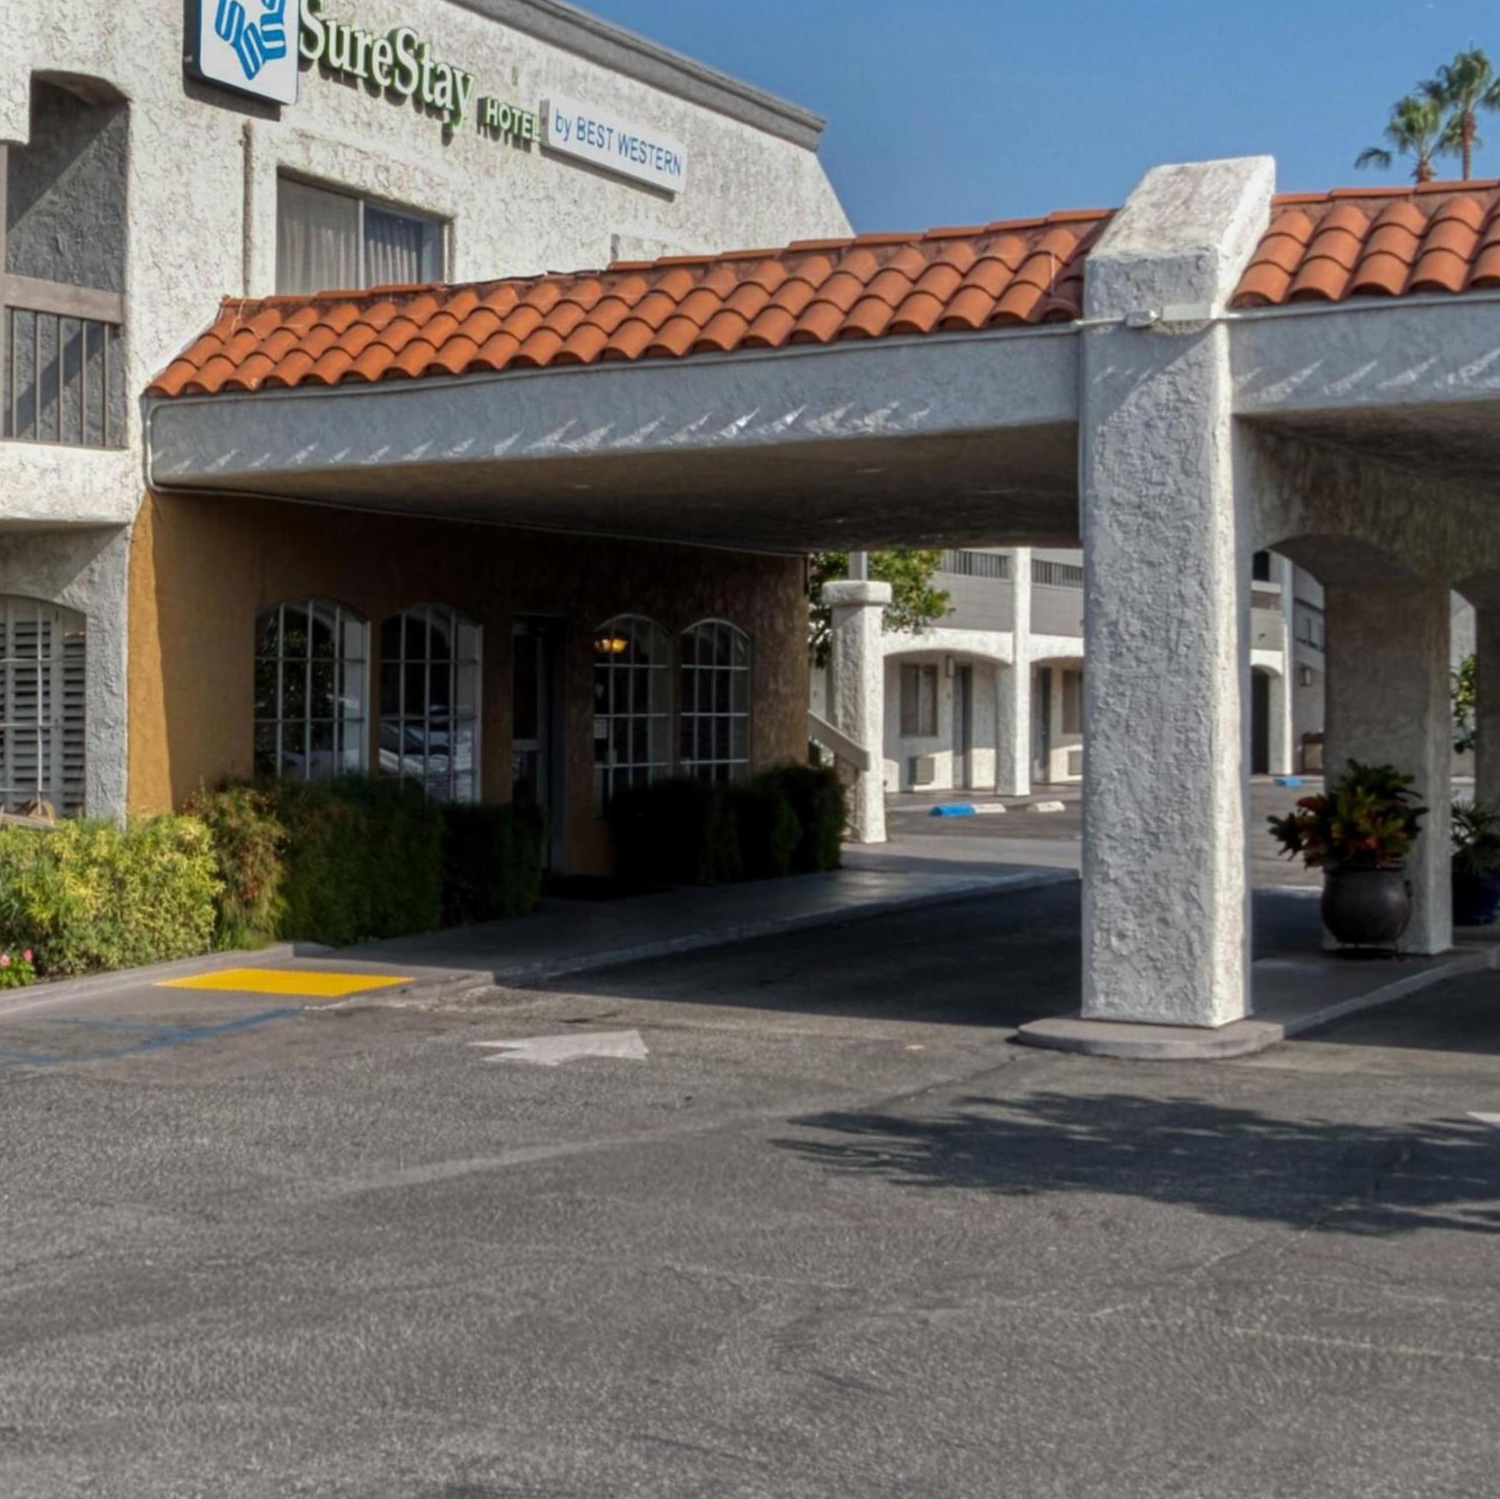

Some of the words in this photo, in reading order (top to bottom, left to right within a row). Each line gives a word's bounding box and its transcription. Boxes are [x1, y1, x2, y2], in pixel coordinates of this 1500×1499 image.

[486, 96, 540, 142] HOTEL
[555, 108, 572, 142] by
[576, 116, 614, 152] BEST
[618, 132, 682, 177] WESTERN
